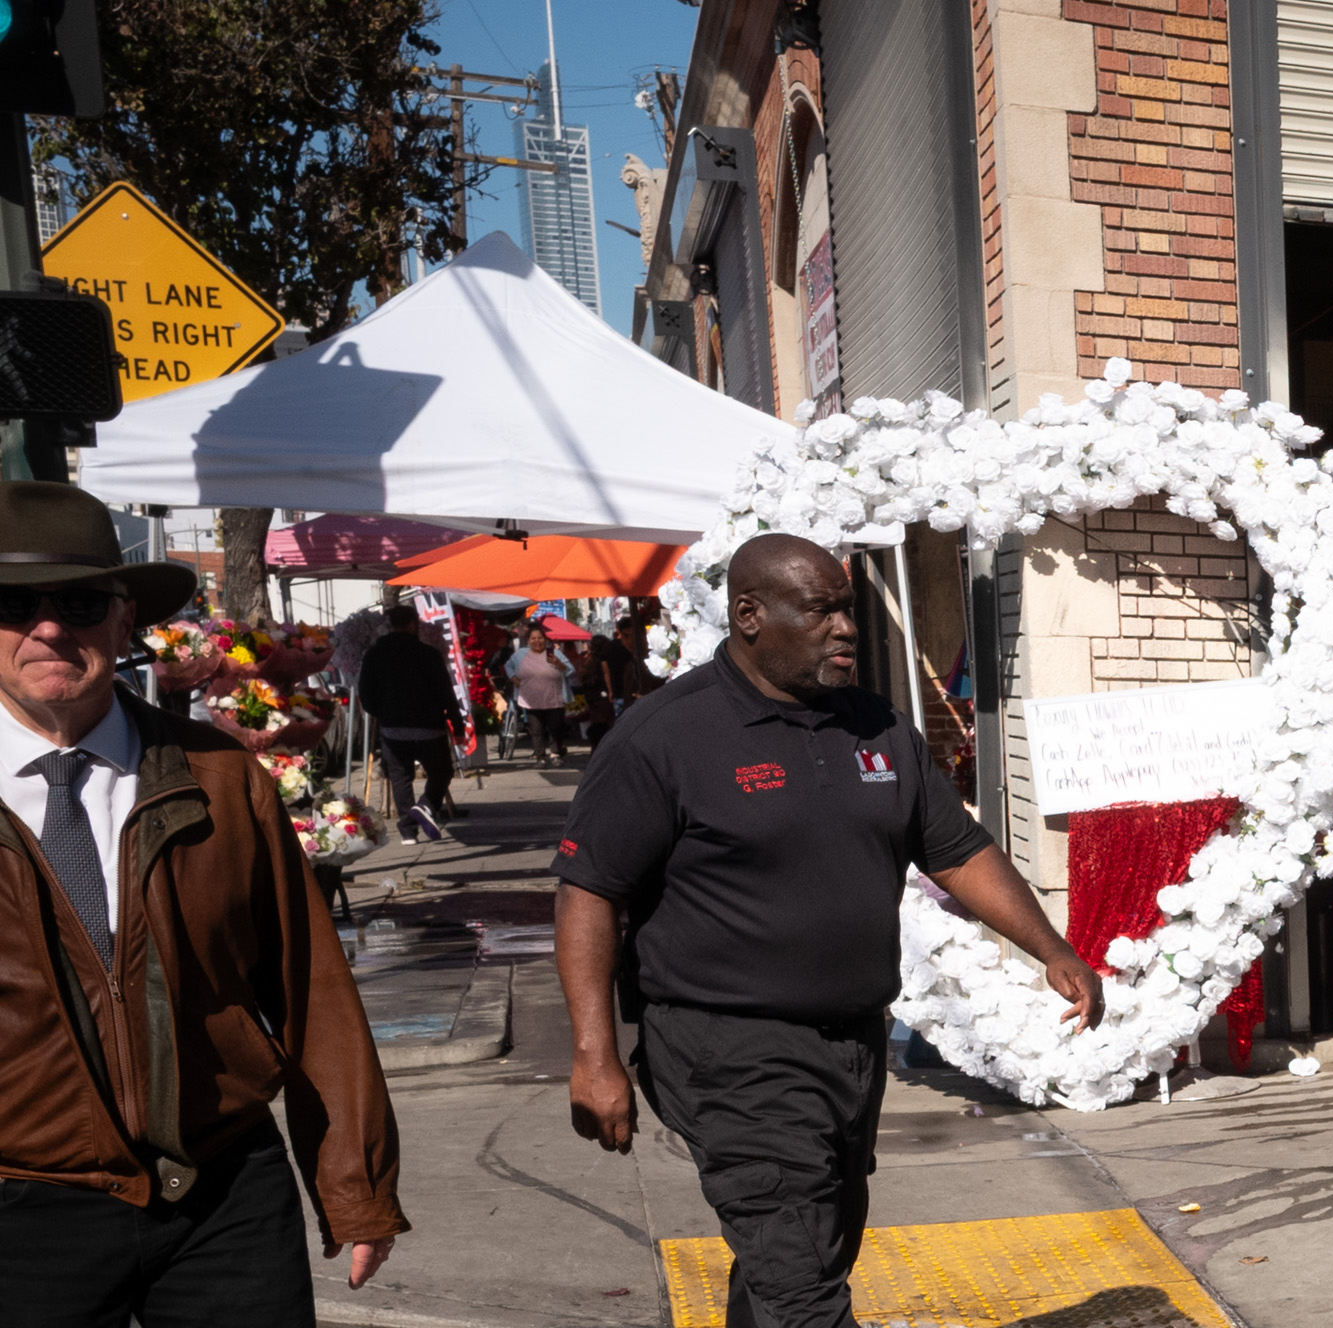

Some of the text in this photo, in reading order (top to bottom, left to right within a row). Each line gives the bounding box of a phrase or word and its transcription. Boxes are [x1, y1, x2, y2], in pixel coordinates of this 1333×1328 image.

[145, 282, 222, 309] LANE
[152, 320, 236, 347] RIGHT
[117, 357, 191, 382] HEAD
